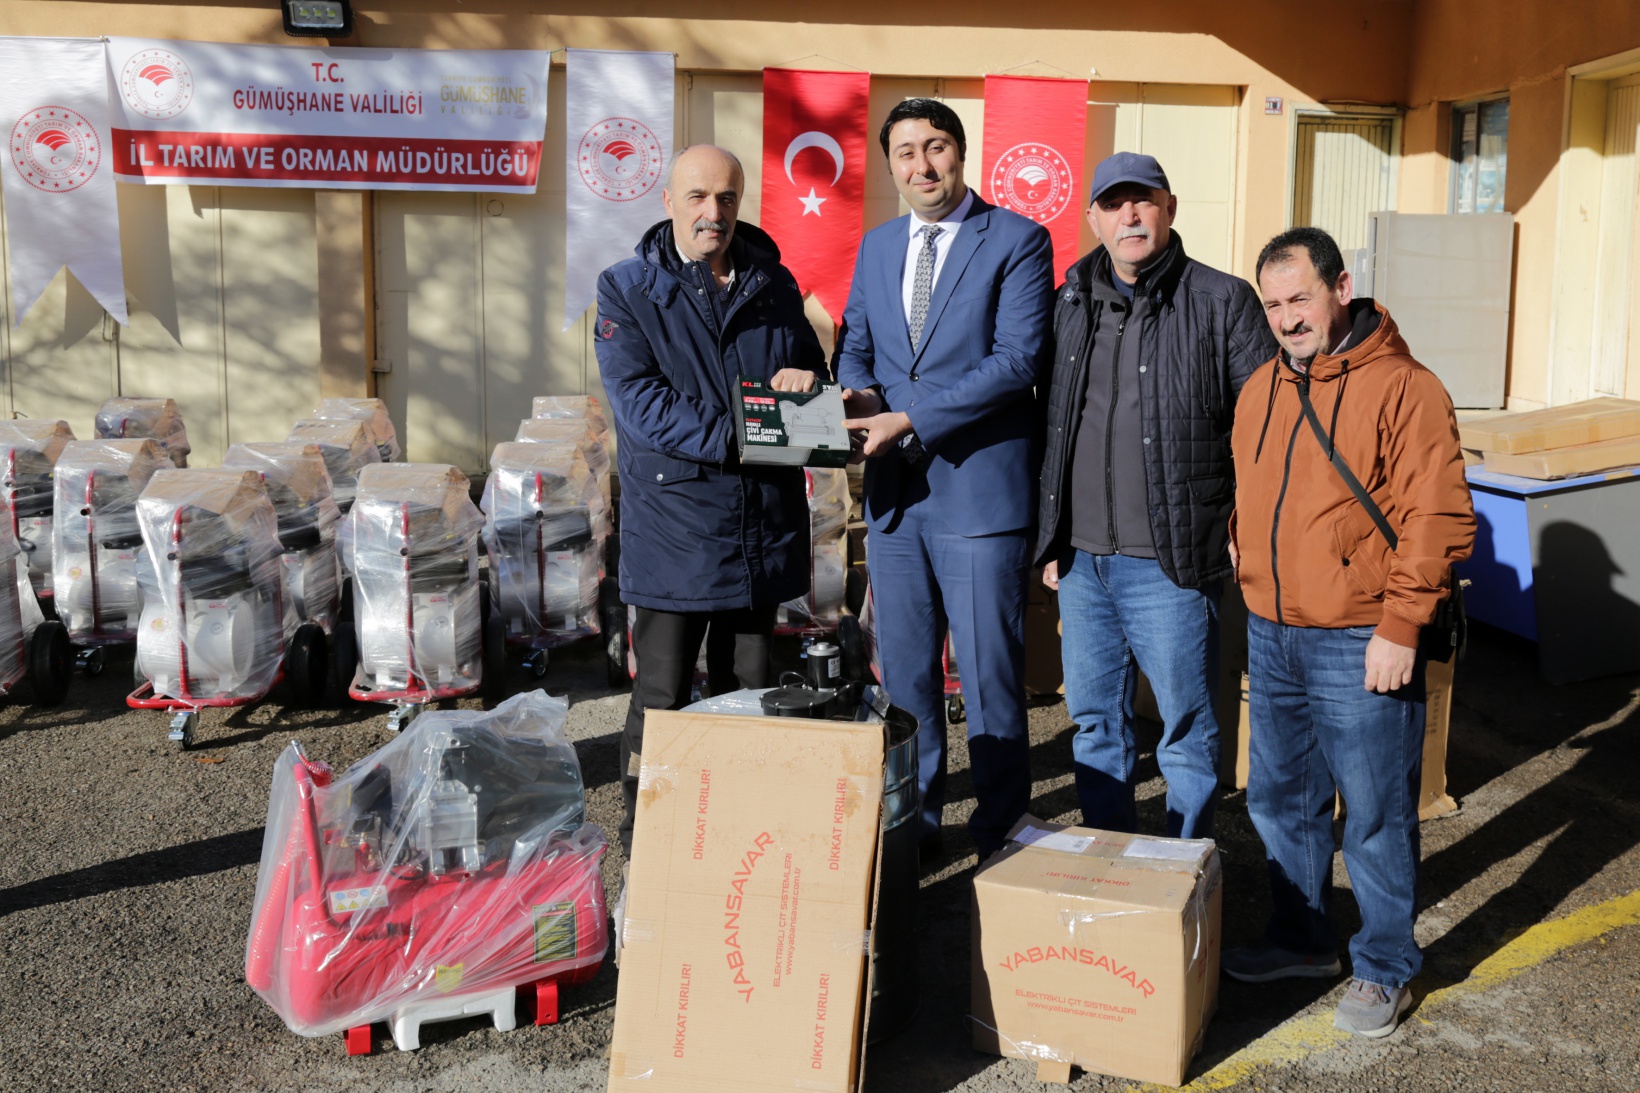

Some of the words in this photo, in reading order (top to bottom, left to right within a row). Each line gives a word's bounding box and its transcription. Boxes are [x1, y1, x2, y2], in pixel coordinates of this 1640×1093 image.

[311, 62, 344, 83] T.C.
[233, 86, 344, 116] GÜMÜŞHANE
[350, 90, 422, 115] VALİLİĞİ
[441, 84, 526, 106] GÜMÜŞHANE
[130, 138, 154, 166] İL
[158, 144, 236, 168] TARIM
[242, 146, 274, 170] VE
[282, 147, 368, 172] ORMAN
[376, 146, 528, 176] MÜDÜRLÜĞÜ
[746, 426, 759, 435] ÇİVİ
[760, 428, 782, 436] ÇAKMA
[747, 434, 777, 442] MAKİNESİ
[698, 769, 711, 814] KIRILIR!
[834, 777, 848, 824] KIRILIR!
[692, 816, 706, 860] DİKKAT
[828, 826, 842, 870] DİKKAT
[1090, 878, 1130, 886] DİKKAT
[724, 831, 775, 1004] YABANSAVAR
[786, 866, 801, 976] www.yabansavar.com.tr
[678, 964, 692, 1010] KIRILIR!
[999, 945, 1156, 1000] YABANSAVAR
[816, 973, 830, 1020] KIRILIR!
[1026, 1001, 1124, 1022] www.yabansavar.com.tr
[673, 1013, 687, 1058] DİKKAT
[810, 1023, 825, 1070] DİKKAT
